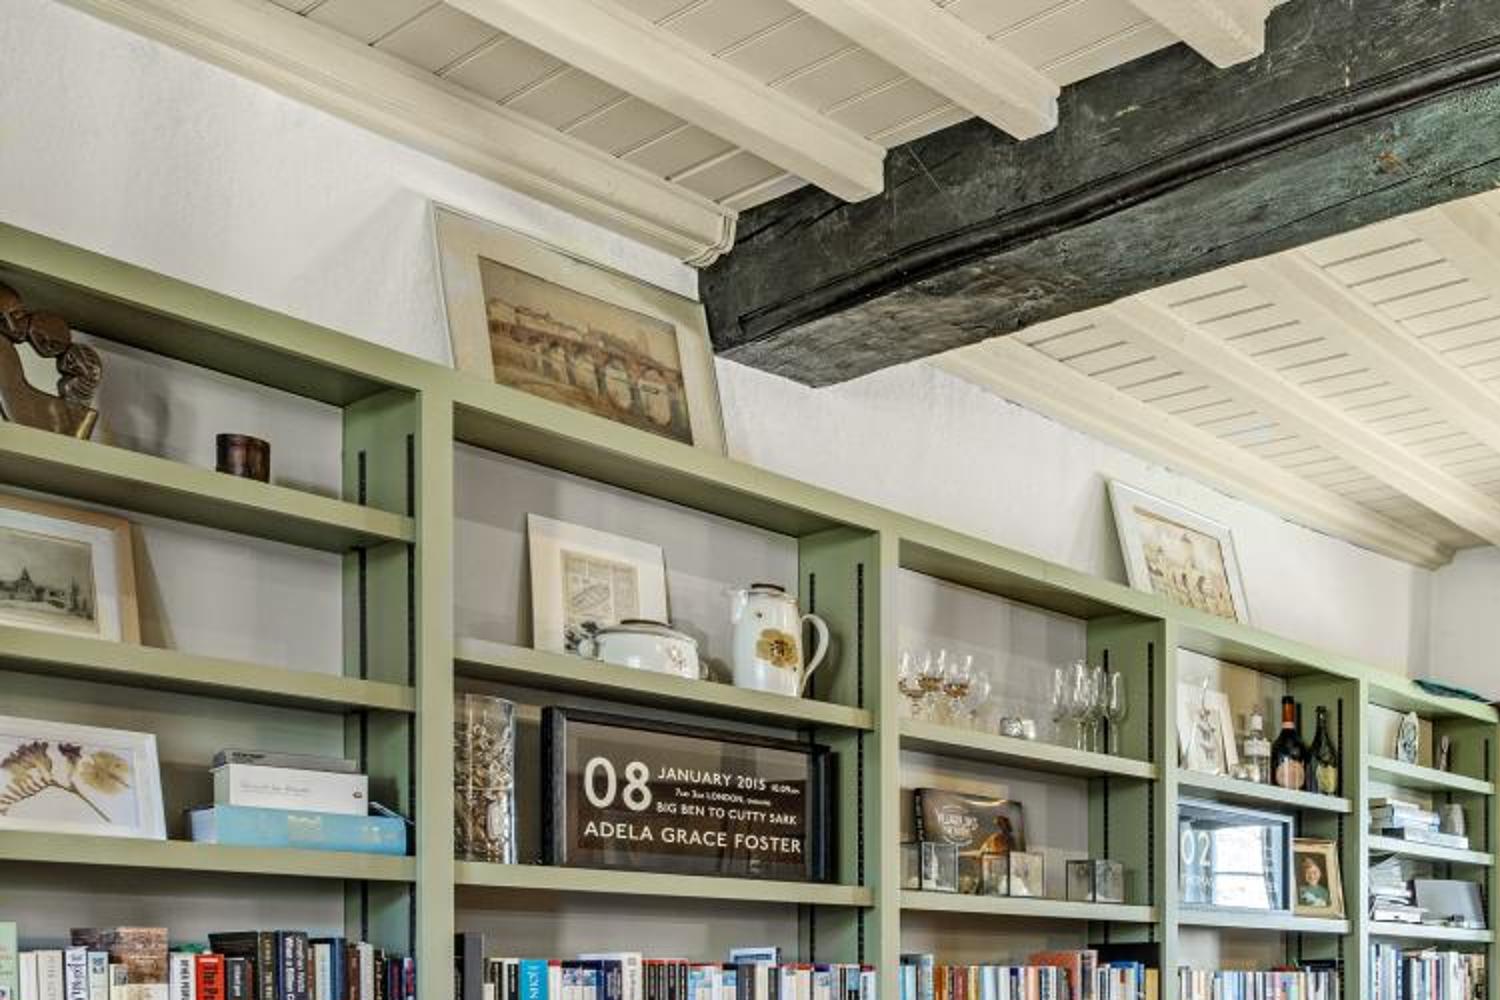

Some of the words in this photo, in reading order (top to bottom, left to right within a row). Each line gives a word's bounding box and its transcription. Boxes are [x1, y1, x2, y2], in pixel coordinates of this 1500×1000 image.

[584, 757, 652, 811] 08
[658, 768, 732, 787] JANUARY
[737, 776, 767, 791] 2015
[656, 802, 677, 814] BIG
[681, 804, 705, 817] BEN
[708, 807, 725, 819] TO
[729, 809, 766, 823] CUTTY
[769, 813, 797, 825] SARK
[584, 821, 653, 841] ADELA
[661, 828, 727, 847] GRACE
[734, 834, 801, 853] FOSTER
